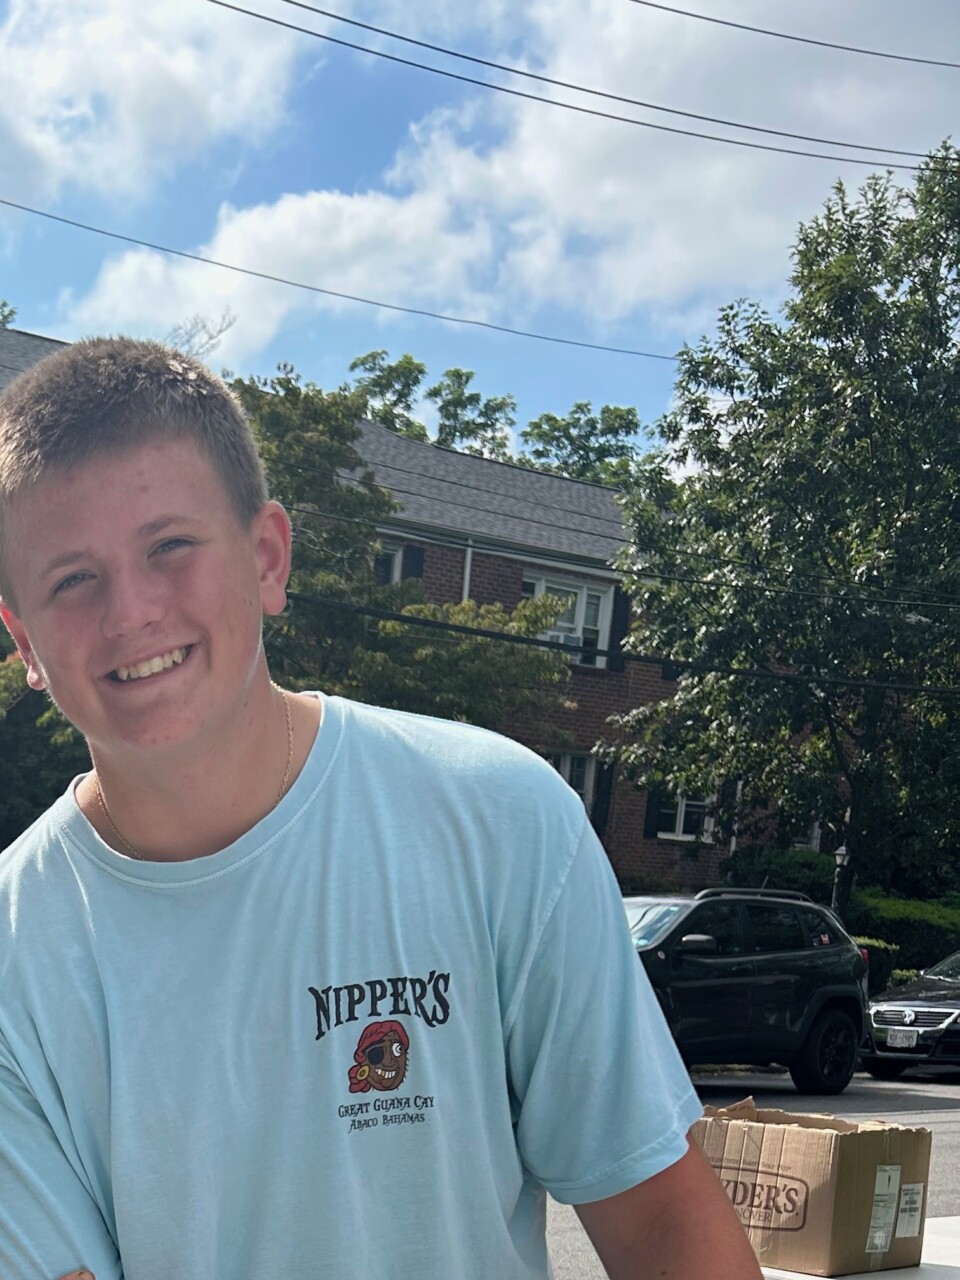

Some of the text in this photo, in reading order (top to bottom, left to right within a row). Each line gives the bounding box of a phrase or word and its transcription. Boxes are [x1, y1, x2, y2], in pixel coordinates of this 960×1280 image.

[308, 970, 450, 1041] NIPPER'S
[338, 1095, 435, 1118] GREAT GUANA CAY
[348, 1112, 426, 1133] ABACO BAHAMAS
